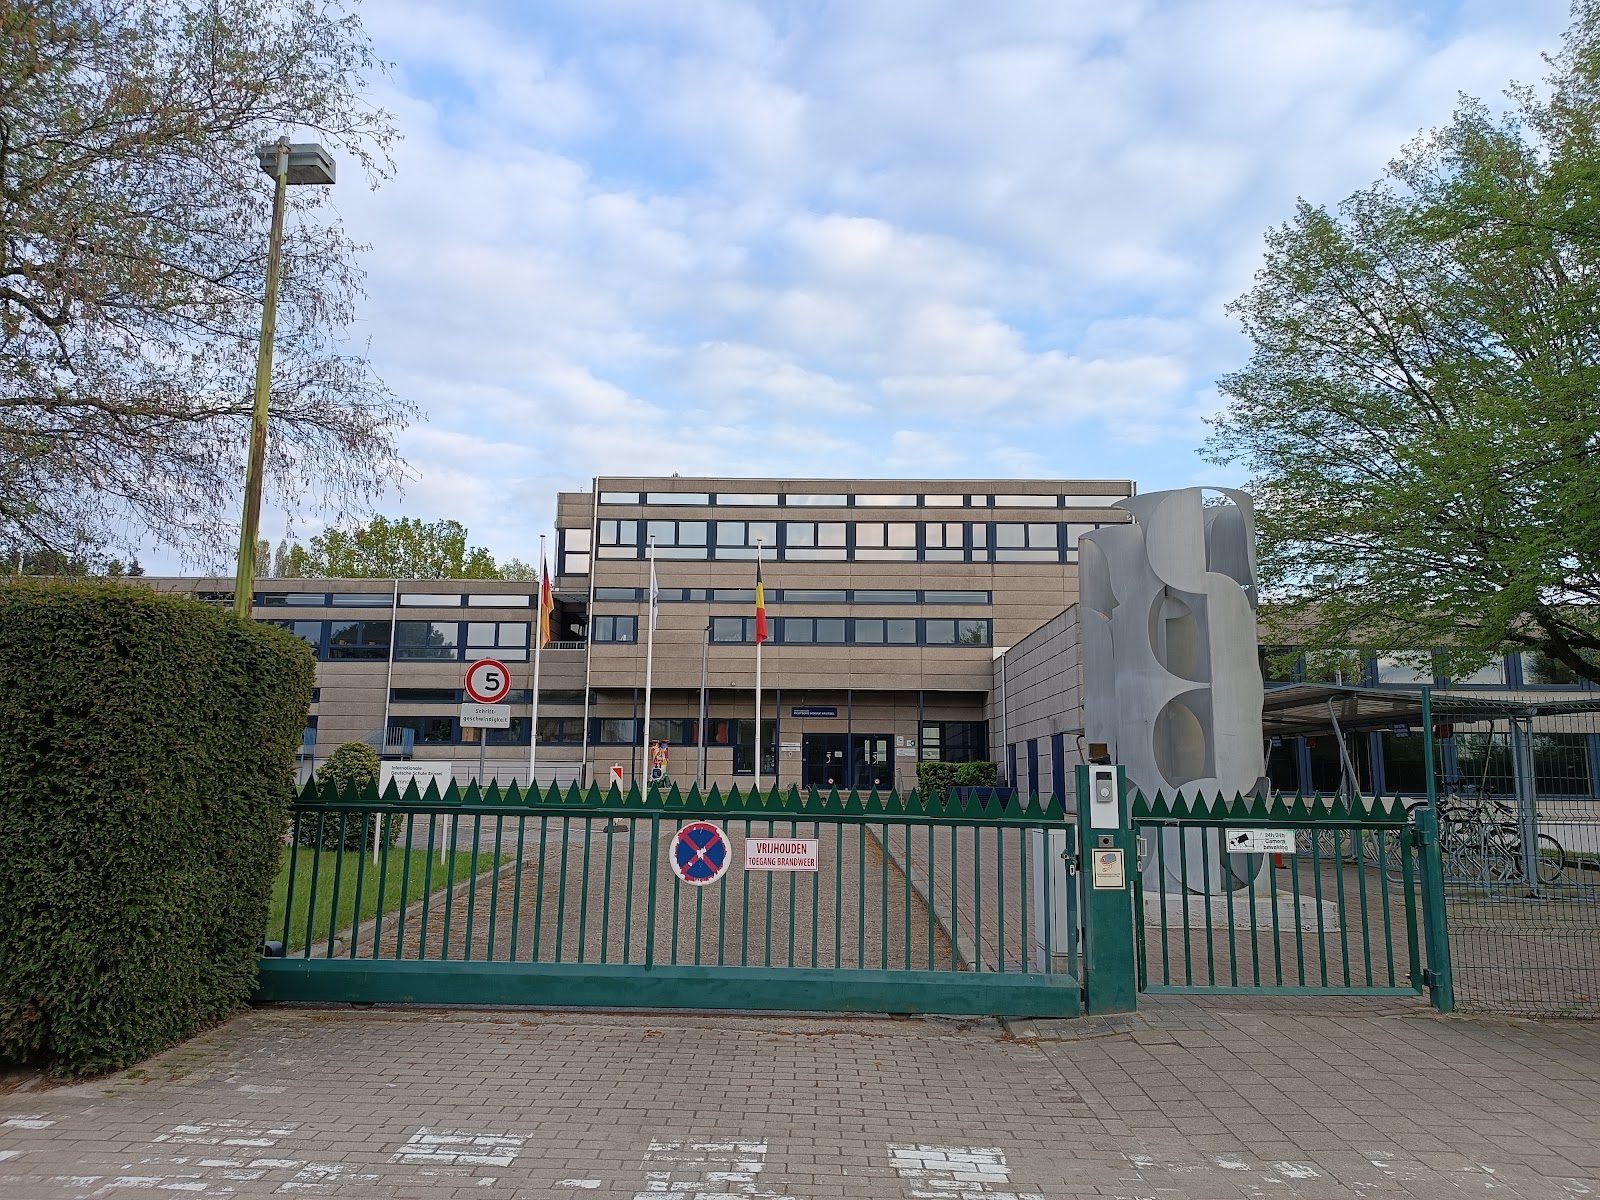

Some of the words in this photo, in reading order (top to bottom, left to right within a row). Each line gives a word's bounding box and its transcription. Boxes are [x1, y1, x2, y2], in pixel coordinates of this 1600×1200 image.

[484, 672, 500, 691] 5
[756, 842, 807, 855] VRIJHOUDEN
[749, 857, 776, 866] TOEGANG
[777, 858, 815, 867] BRANDWEER
